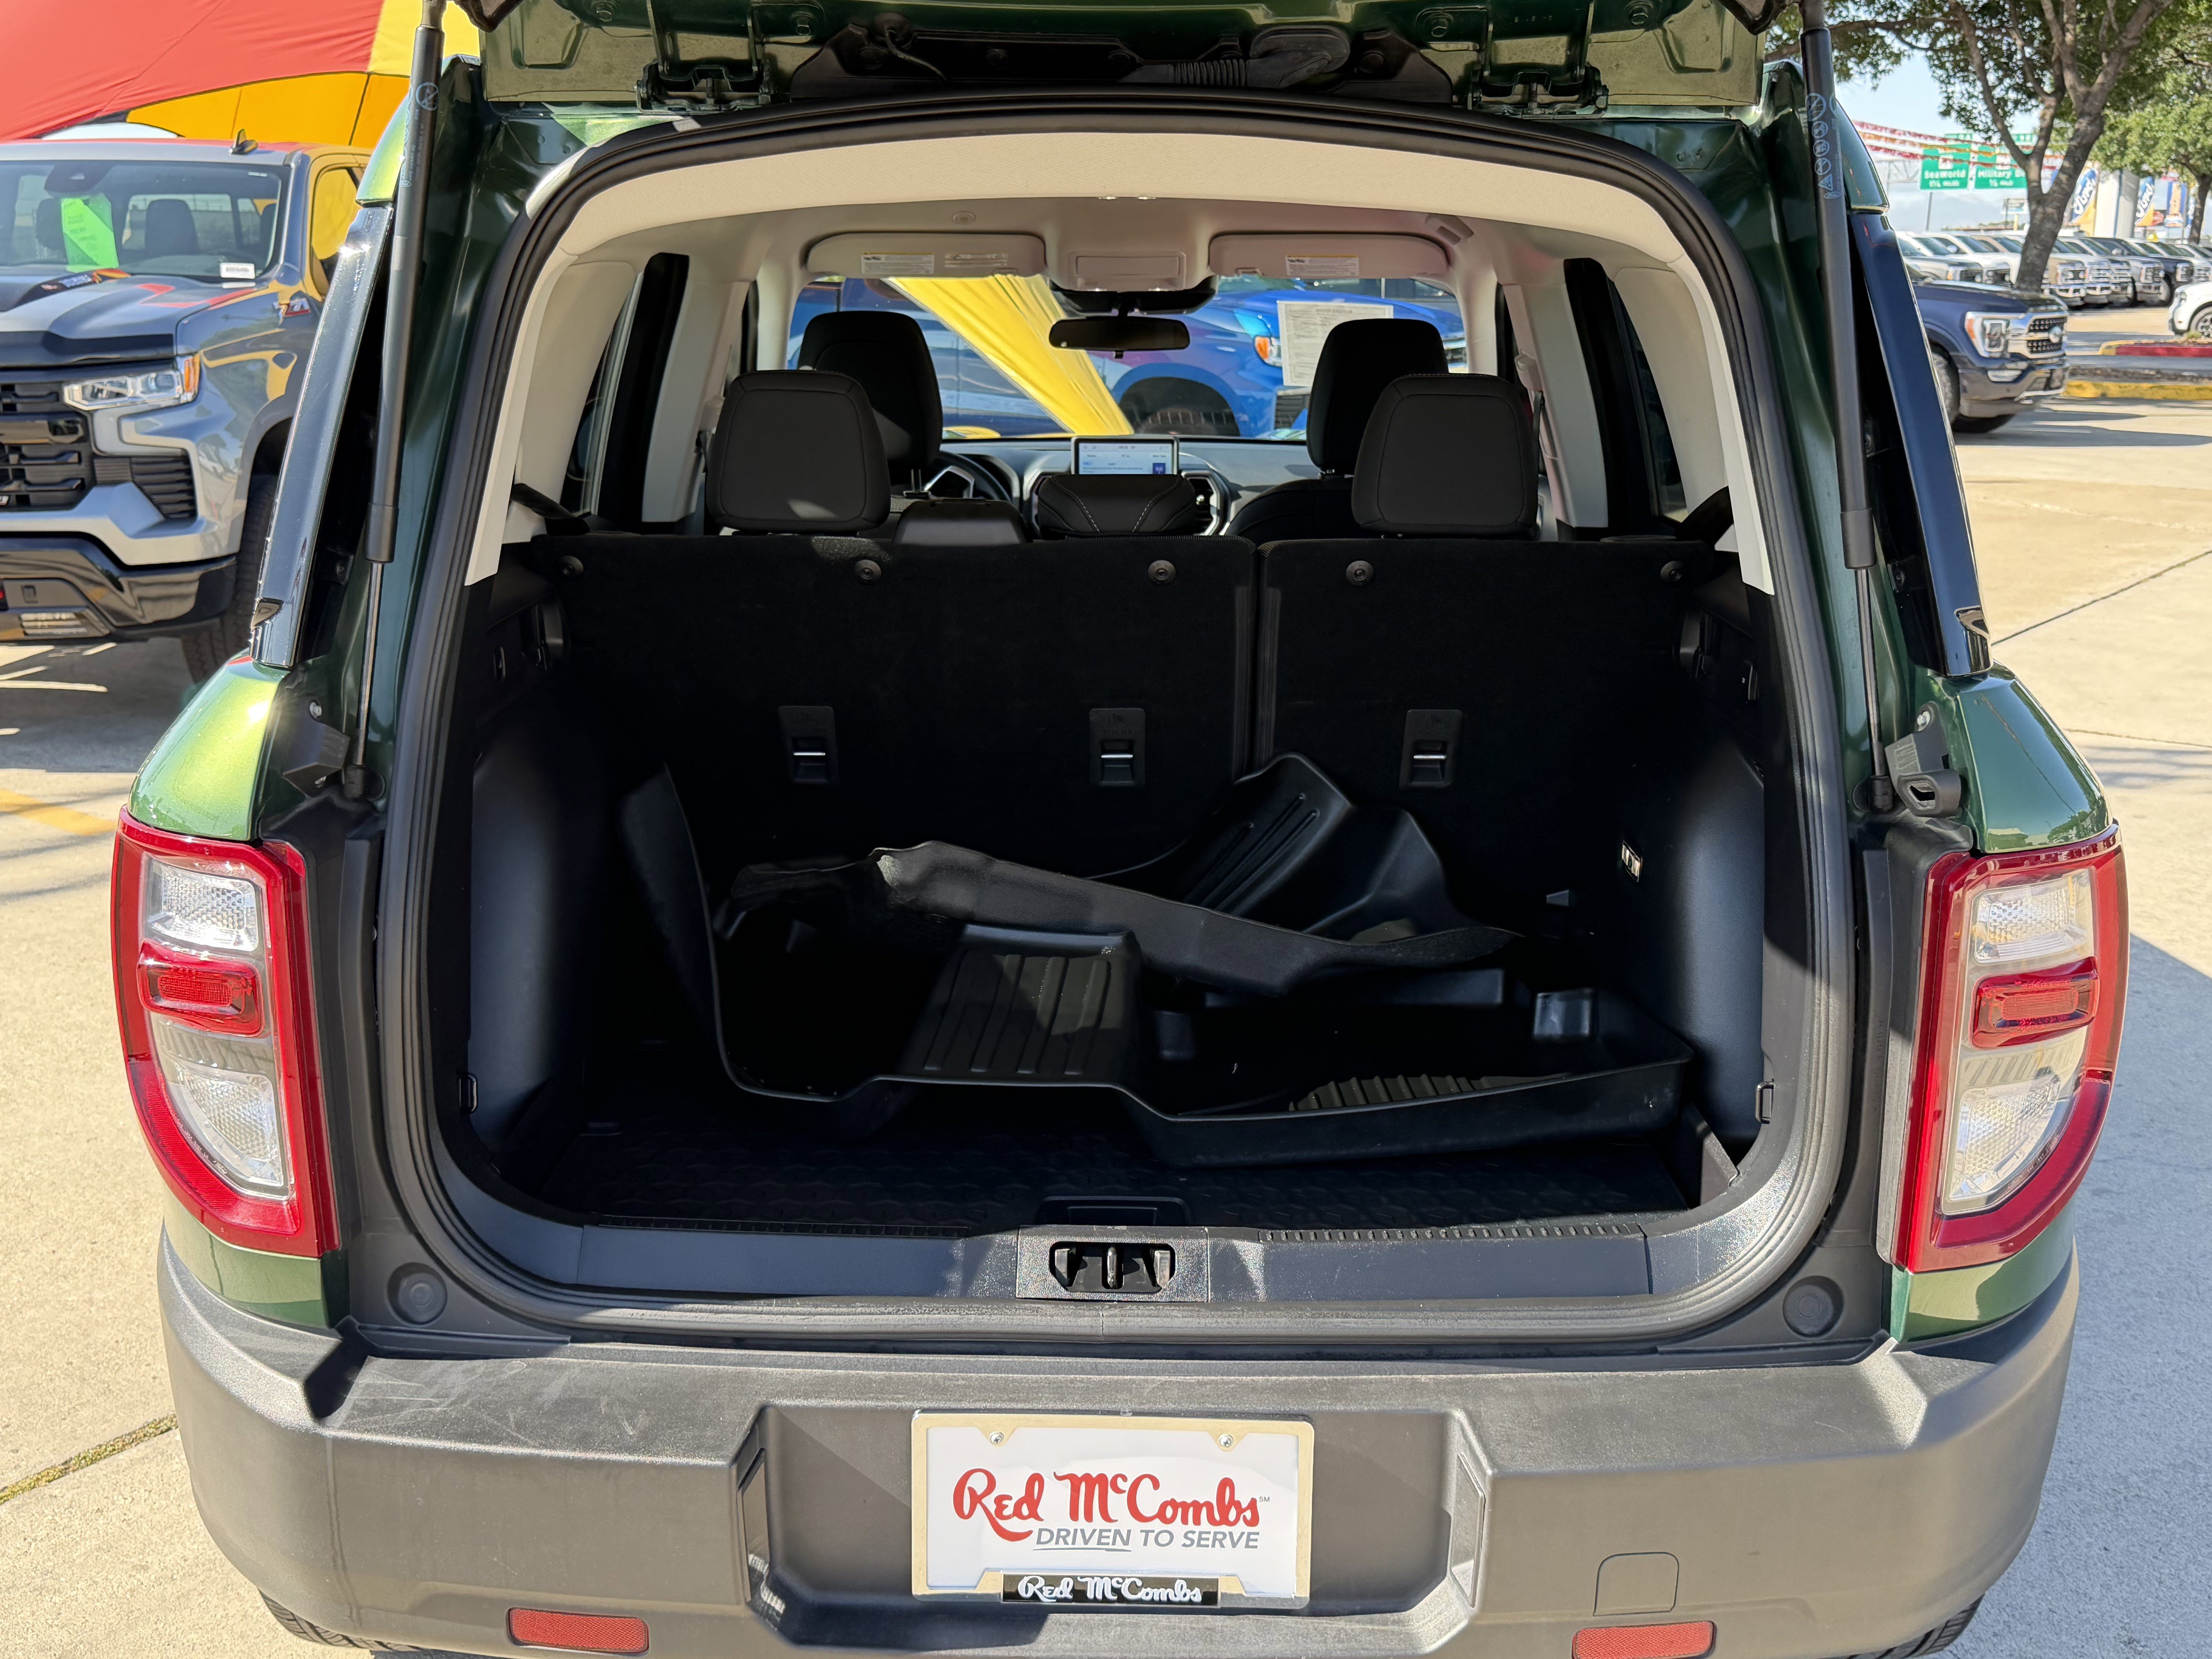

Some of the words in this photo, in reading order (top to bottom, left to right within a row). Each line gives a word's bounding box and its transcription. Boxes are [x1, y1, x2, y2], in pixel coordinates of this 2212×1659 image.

[953, 1468, 1044, 1542] Red
[1053, 1471, 1259, 1527] McCombs
[1036, 1528, 1132, 1546] DRIVEN
[1140, 1529, 1174, 1547] TO
[1182, 1530, 1260, 1549] SERVE
[1018, 1575, 1073, 1602] Red
[1077, 1576, 1202, 1603] McCombs
